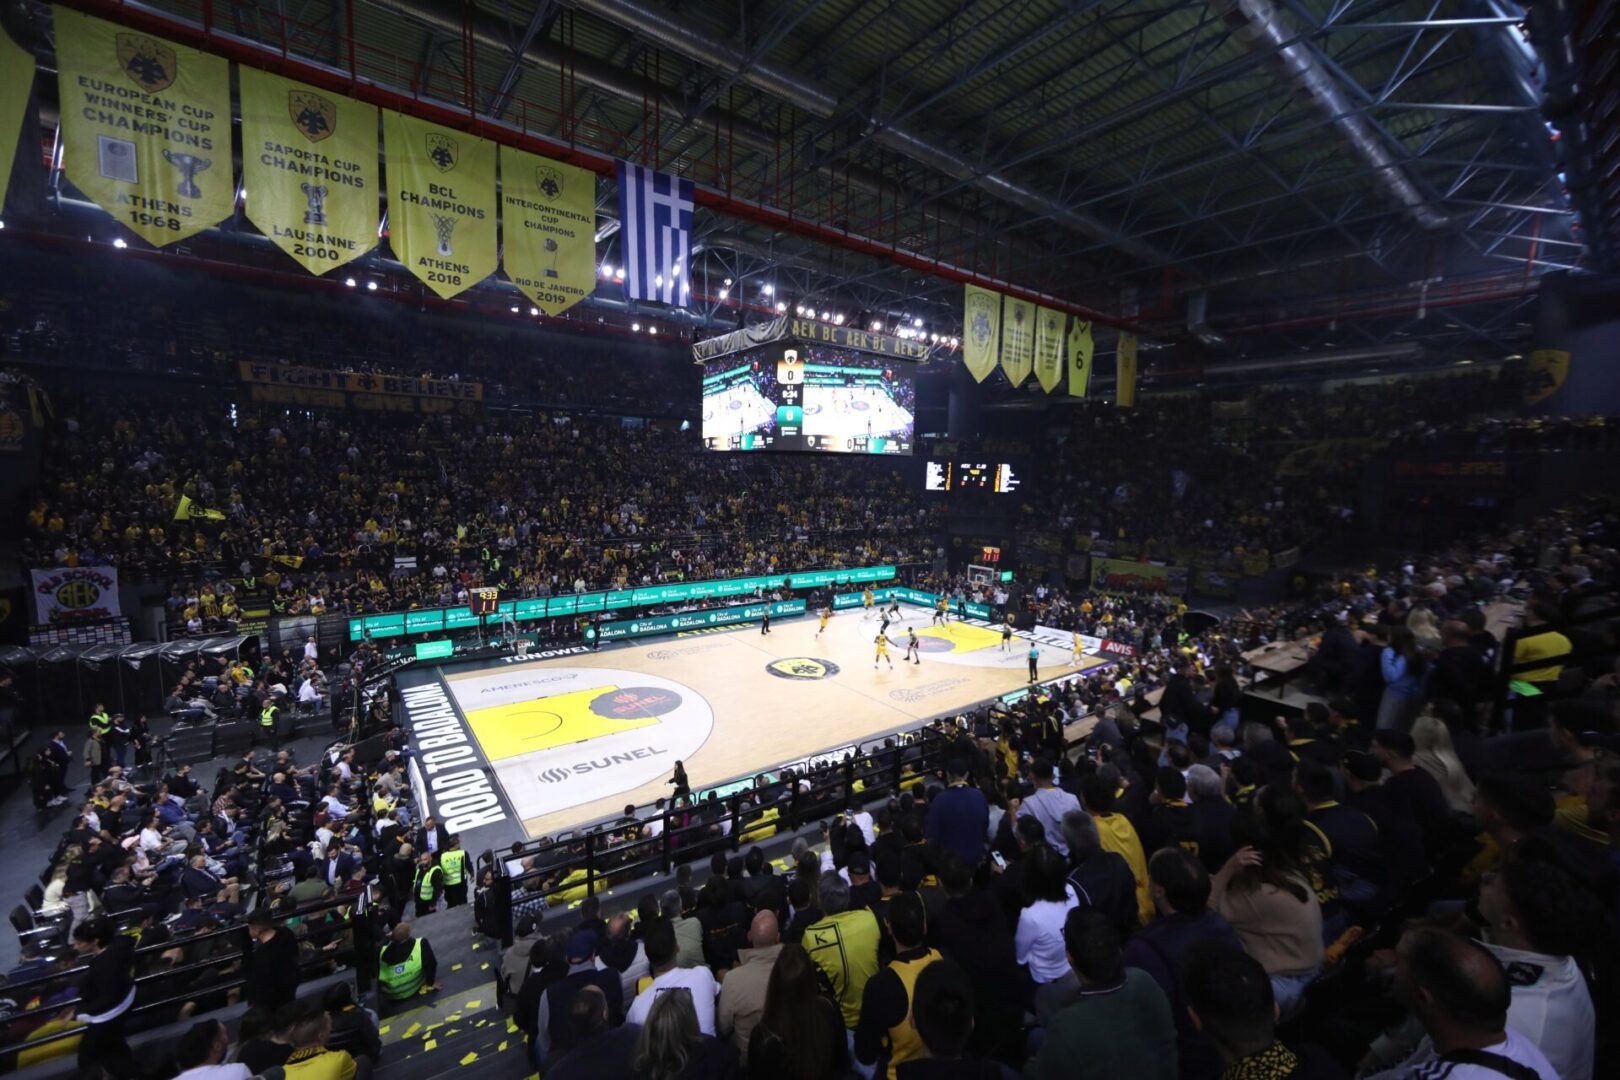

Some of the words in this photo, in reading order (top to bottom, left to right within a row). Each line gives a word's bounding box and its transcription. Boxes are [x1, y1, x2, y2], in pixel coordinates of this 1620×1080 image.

[78, 76, 177, 111] EUROPEAN
[182, 105, 214, 122] CUP
[84, 92, 173, 124] WINNERS'
[178, 115, 210, 134] CUP
[82, 107, 213, 151] CHAMPIONS
[264, 140, 329, 166] SAPORTA
[334, 158, 361, 174] CUP
[260, 154, 364, 189] CHAMPIONS
[429, 183, 457, 200] BCL
[116, 192, 192, 218] ATHENS
[400, 190, 485, 220] CHAMPIONS
[505, 196, 591, 224] INTERCONTINENTAL
[129, 210, 182, 232] 1968
[524, 220, 576, 238] CHAMPIONS
[541, 214, 560, 225] CUP
[272, 225, 356, 251] LAUSANNE
[294, 244, 340, 262] 2000
[418, 256, 470, 274] ATHENS
[427, 270, 462, 287] 2018
[516, 277, 532, 288] RIO
[534, 278, 546, 290] DE
[548, 282, 584, 296] JANEIRO
[536, 291, 566, 305] 2019
[792, 320, 816, 338] AEK
[822, 326, 838, 342] BC
[846, 330, 867, 348] AEK
[872, 336, 886, 351] BC
[894, 341, 912, 356] AEK
[1076, 350, 1084, 370] 6
[787, 370, 794, 381] 0
[58, 582, 98, 608] AEK
[600, 629, 626, 637] ADALONA
[640, 624, 667, 632] BADALONA
[500, 646, 590, 664] TONGWEI
[1106, 642, 1133, 656] AVIS
[401, 682, 469, 751] BADALONA
[422, 744, 478, 774] TO
[572, 745, 668, 776] SUNEL
[434, 767, 508, 834] ROAD
[814, 932, 828, 945] K
